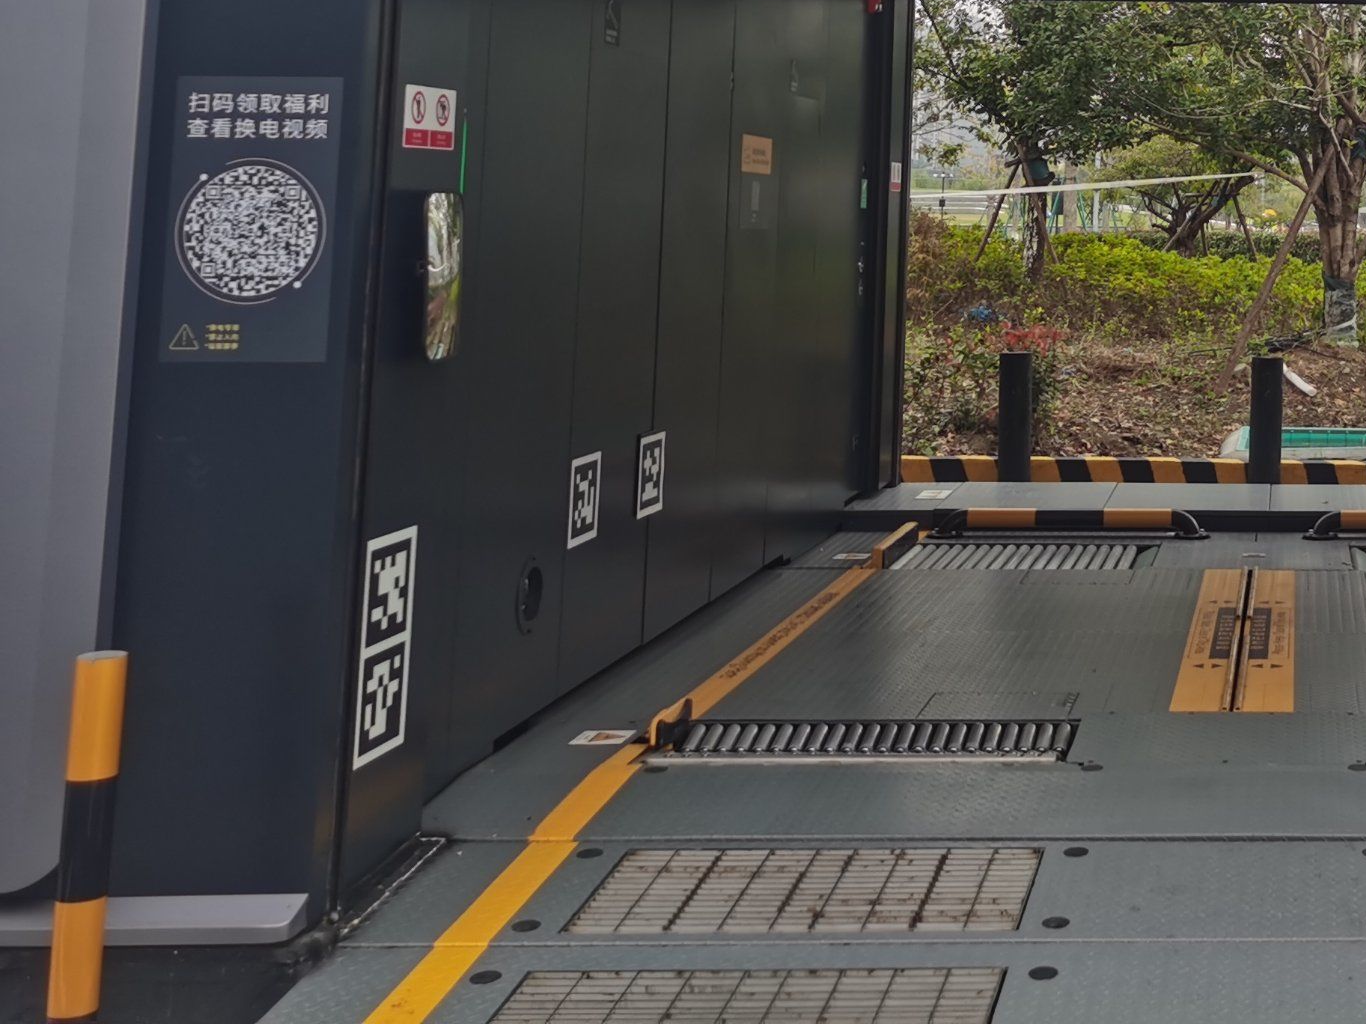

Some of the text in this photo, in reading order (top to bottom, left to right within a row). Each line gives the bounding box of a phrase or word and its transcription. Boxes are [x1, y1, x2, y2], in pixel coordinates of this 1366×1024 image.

[188, 92, 330, 114] 扫码领取福利
[187, 117, 329, 139] 查看换电视频
